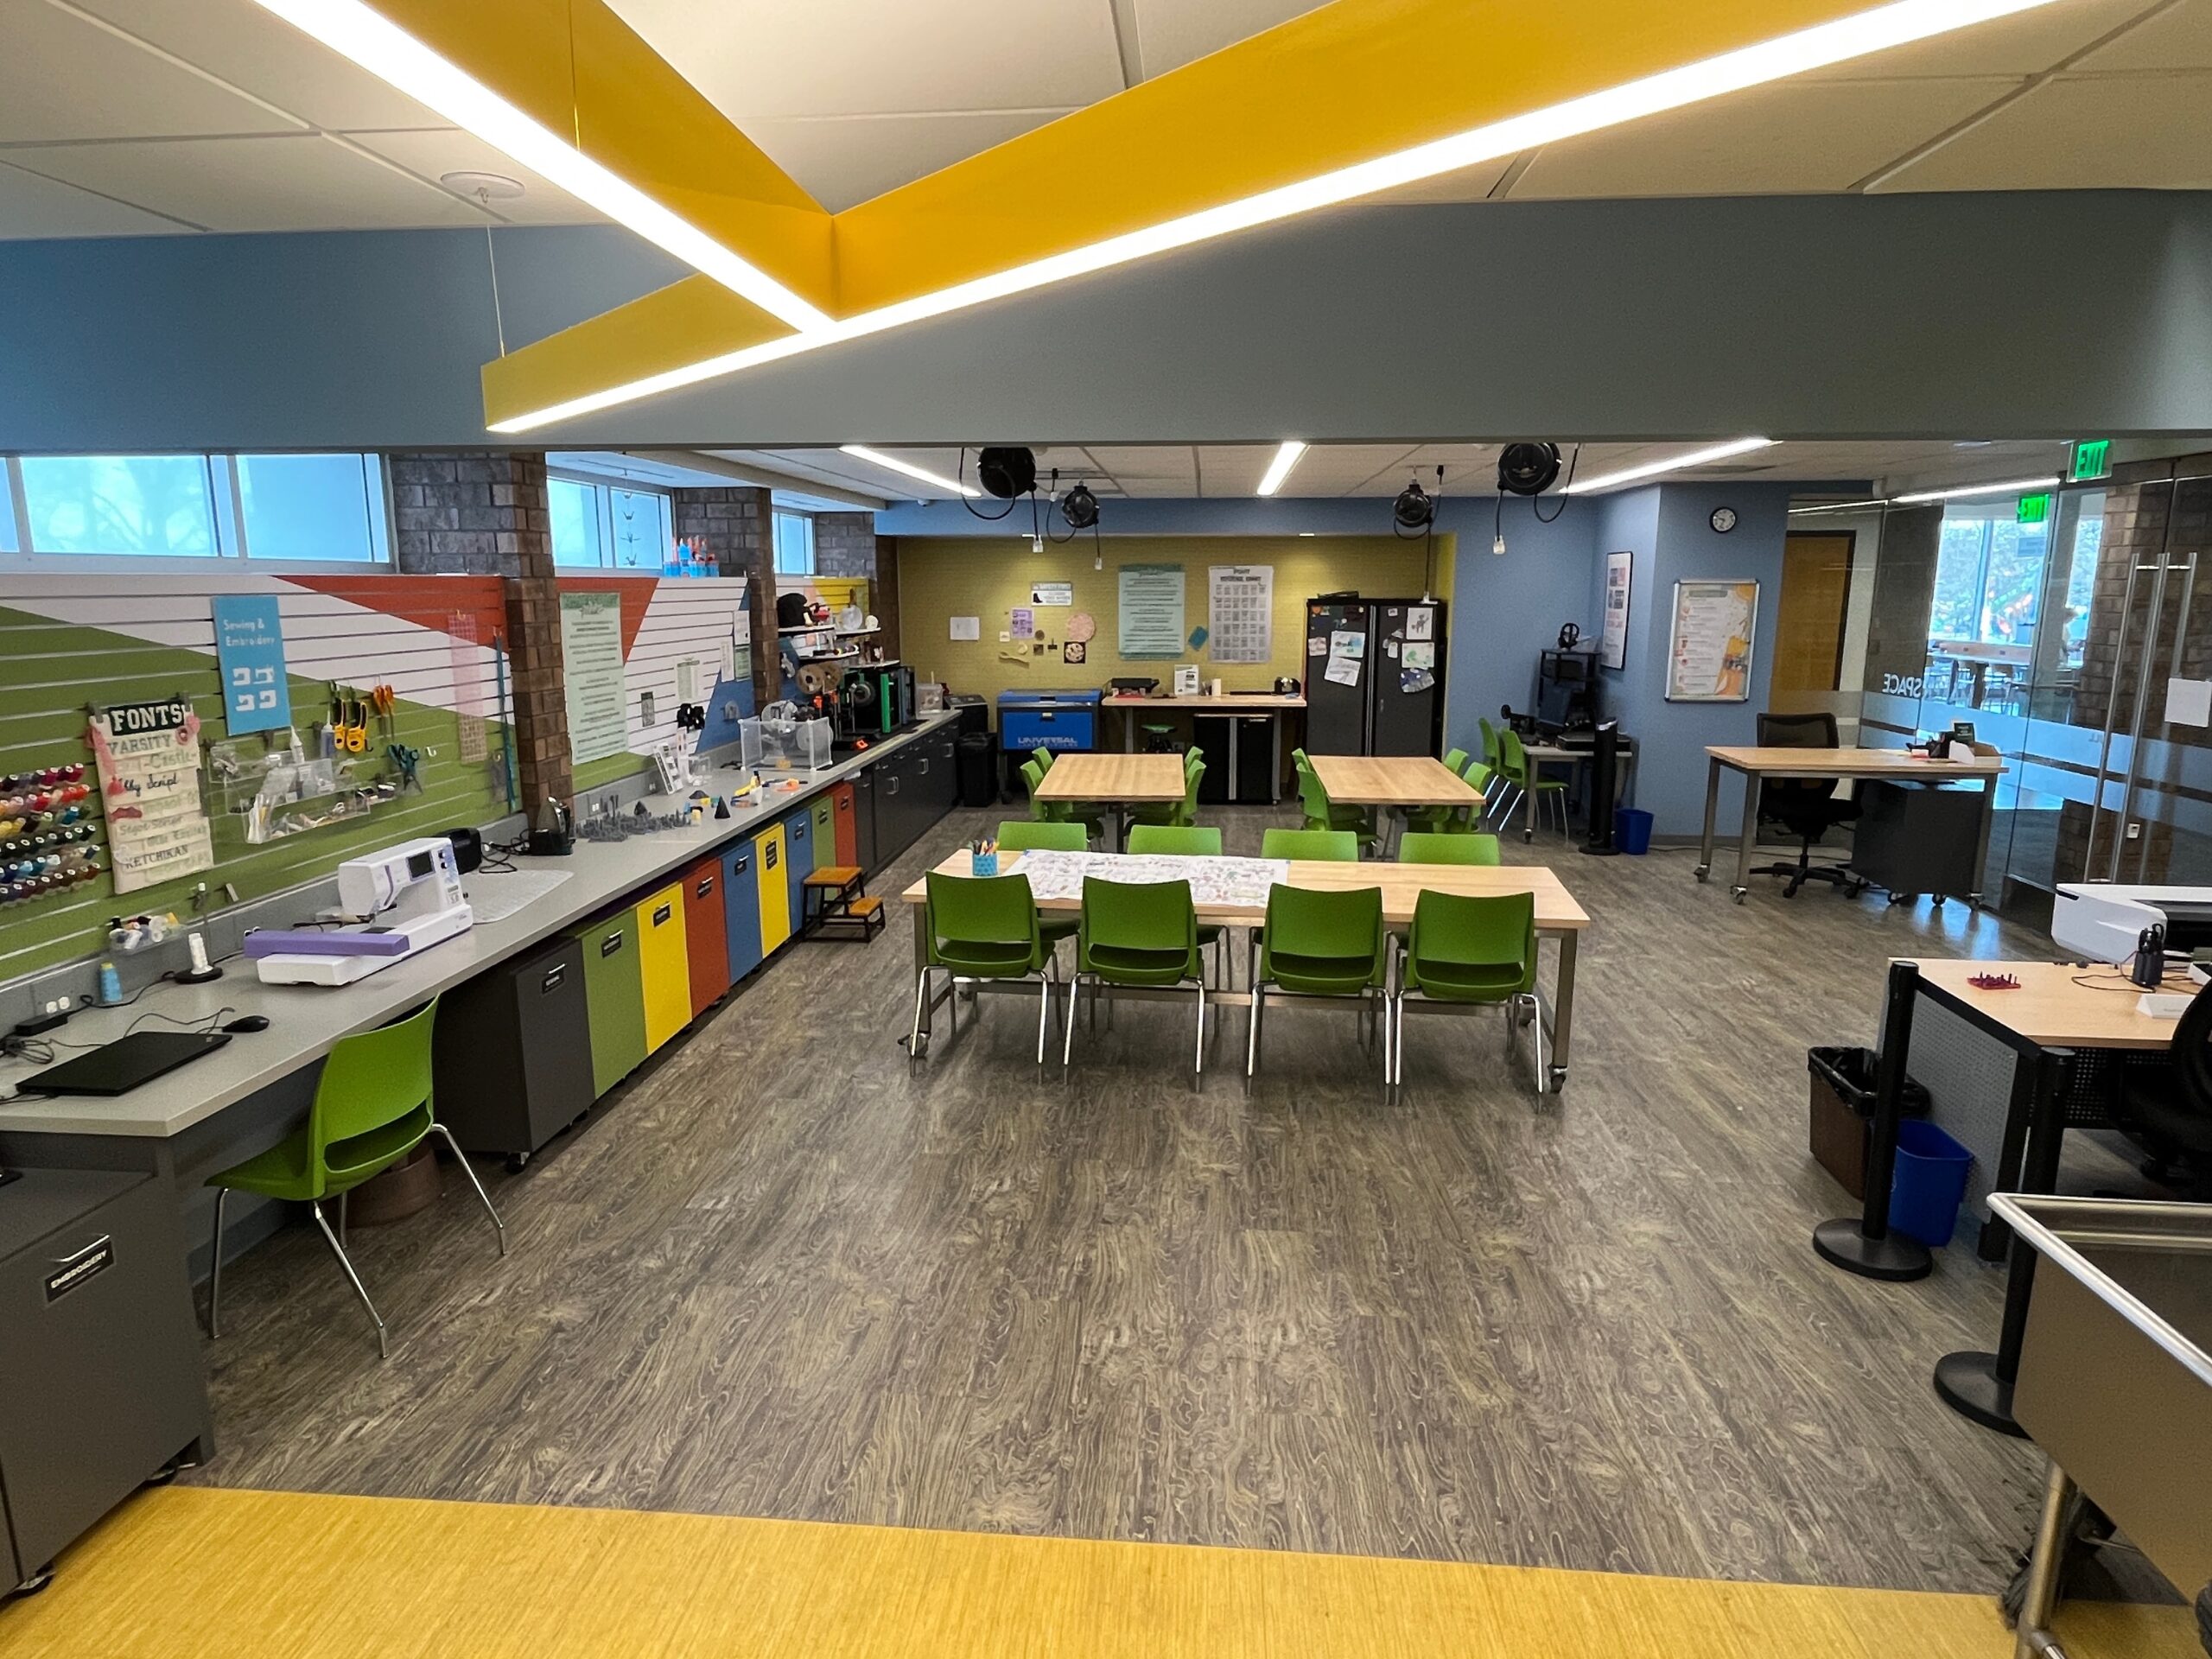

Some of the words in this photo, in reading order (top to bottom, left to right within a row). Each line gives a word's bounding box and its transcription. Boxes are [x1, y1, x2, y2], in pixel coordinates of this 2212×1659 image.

[2075, 441, 2108, 477] EXIT
[223, 619, 255, 632] Sewing
[257, 618, 265, 629] &
[226, 635, 275, 647] Embroidery
[111, 703, 182, 732] FONTS
[105, 734, 172, 756] VARSITY
